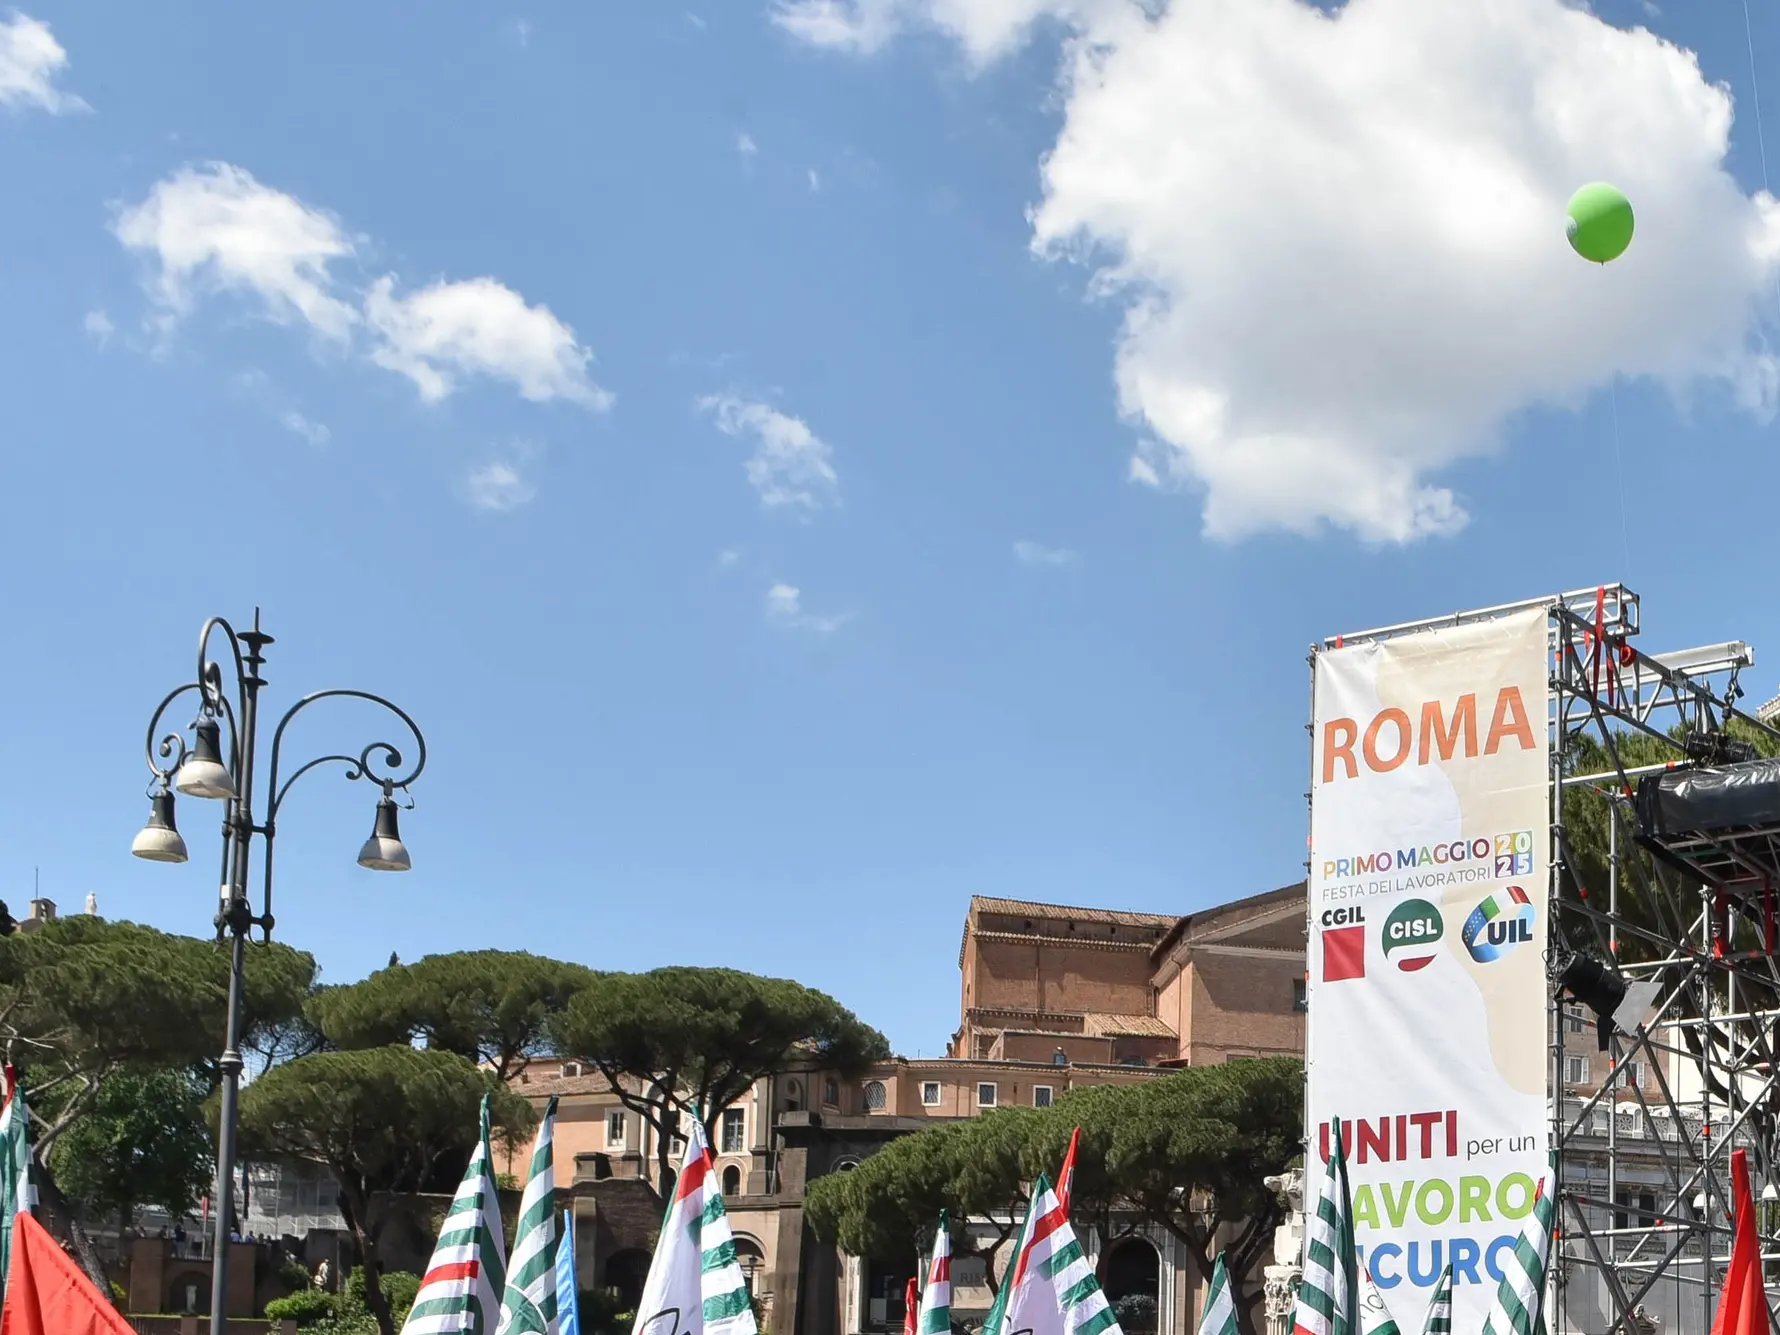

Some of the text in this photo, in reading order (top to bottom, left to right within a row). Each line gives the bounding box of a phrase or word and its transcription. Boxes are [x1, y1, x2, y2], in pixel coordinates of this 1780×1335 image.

[1322, 686, 1537, 784] ROMA
[1322, 865, 1490, 902] FESTA DEI LAVORATORI
[1323, 838, 1490, 881] PRIMO MAGGIO
[1321, 906, 1533, 946] CGIL CISL UIL
[1319, 1110, 1536, 1166] UNITI per un
[1354, 1171, 1537, 1231] AVORO
